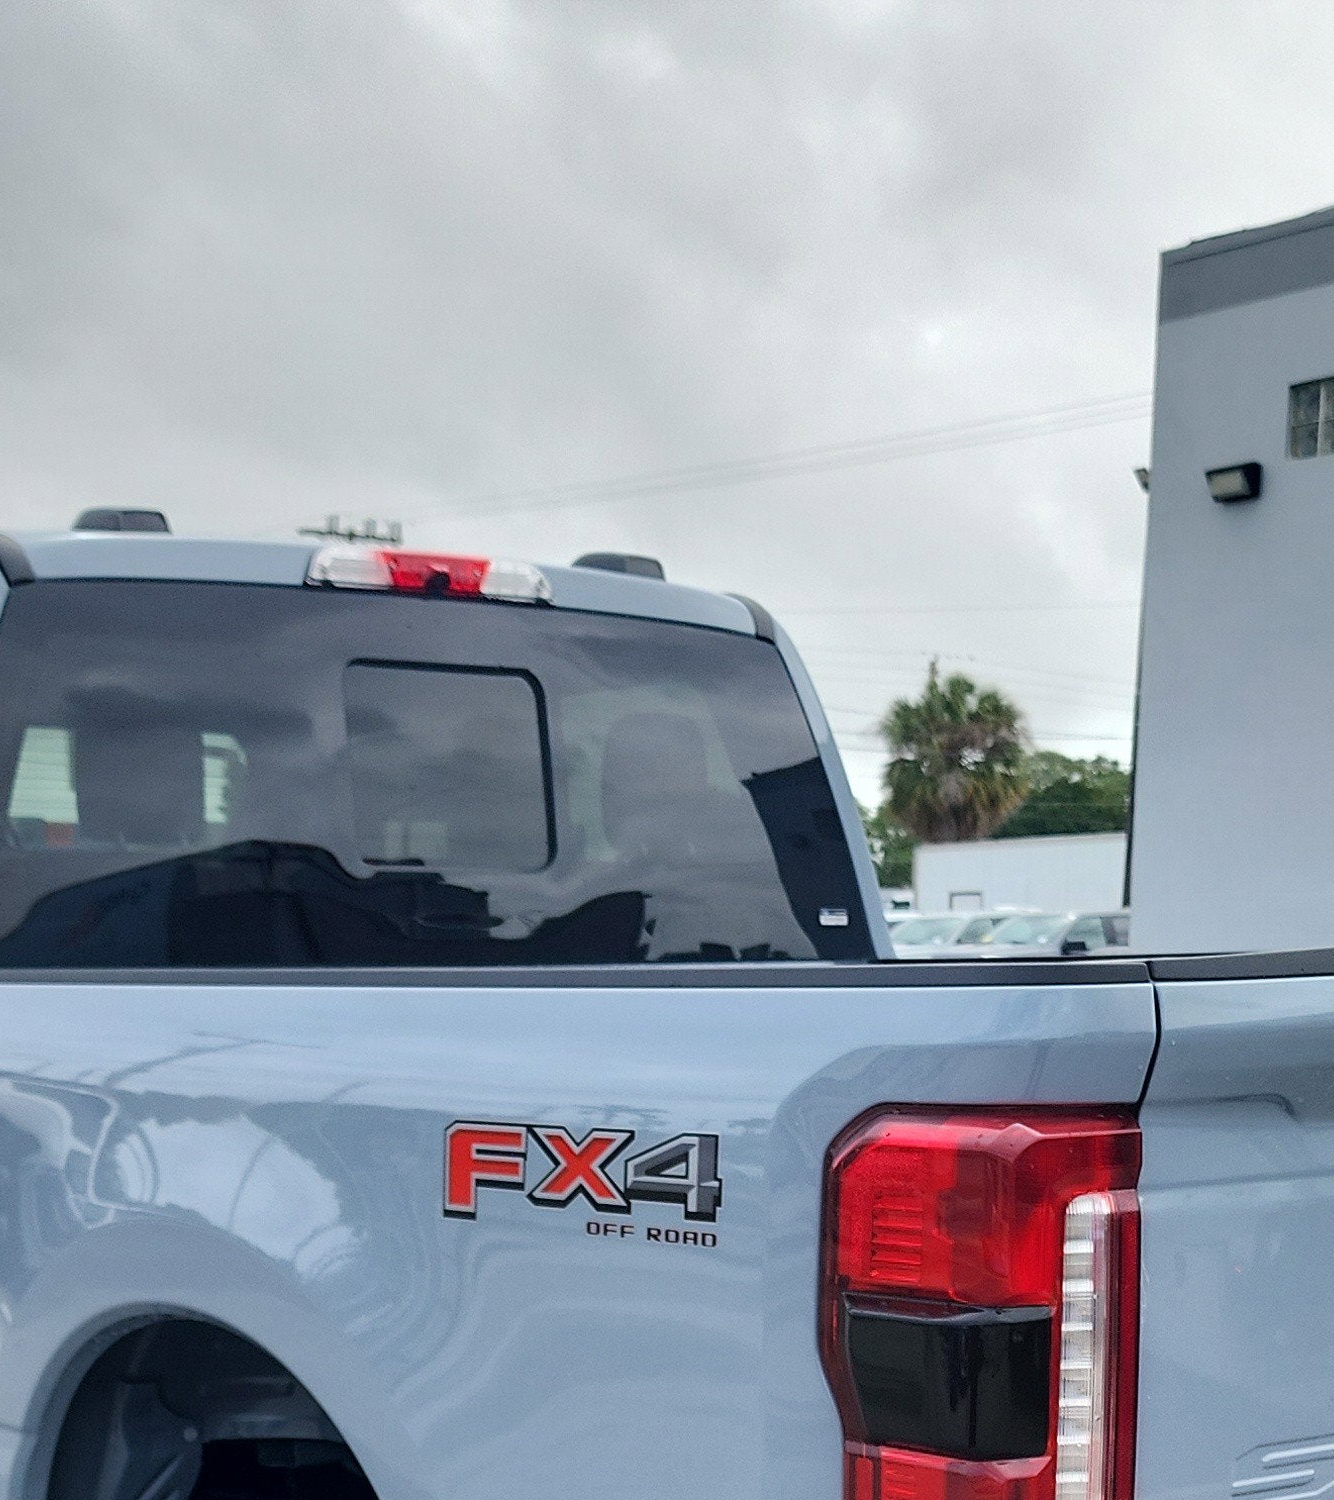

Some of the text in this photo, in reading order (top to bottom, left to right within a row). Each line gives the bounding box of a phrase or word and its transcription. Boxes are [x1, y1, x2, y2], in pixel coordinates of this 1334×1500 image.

[443, 1119, 723, 1223] FX4
[586, 1221, 718, 1248] OFF ROAD
